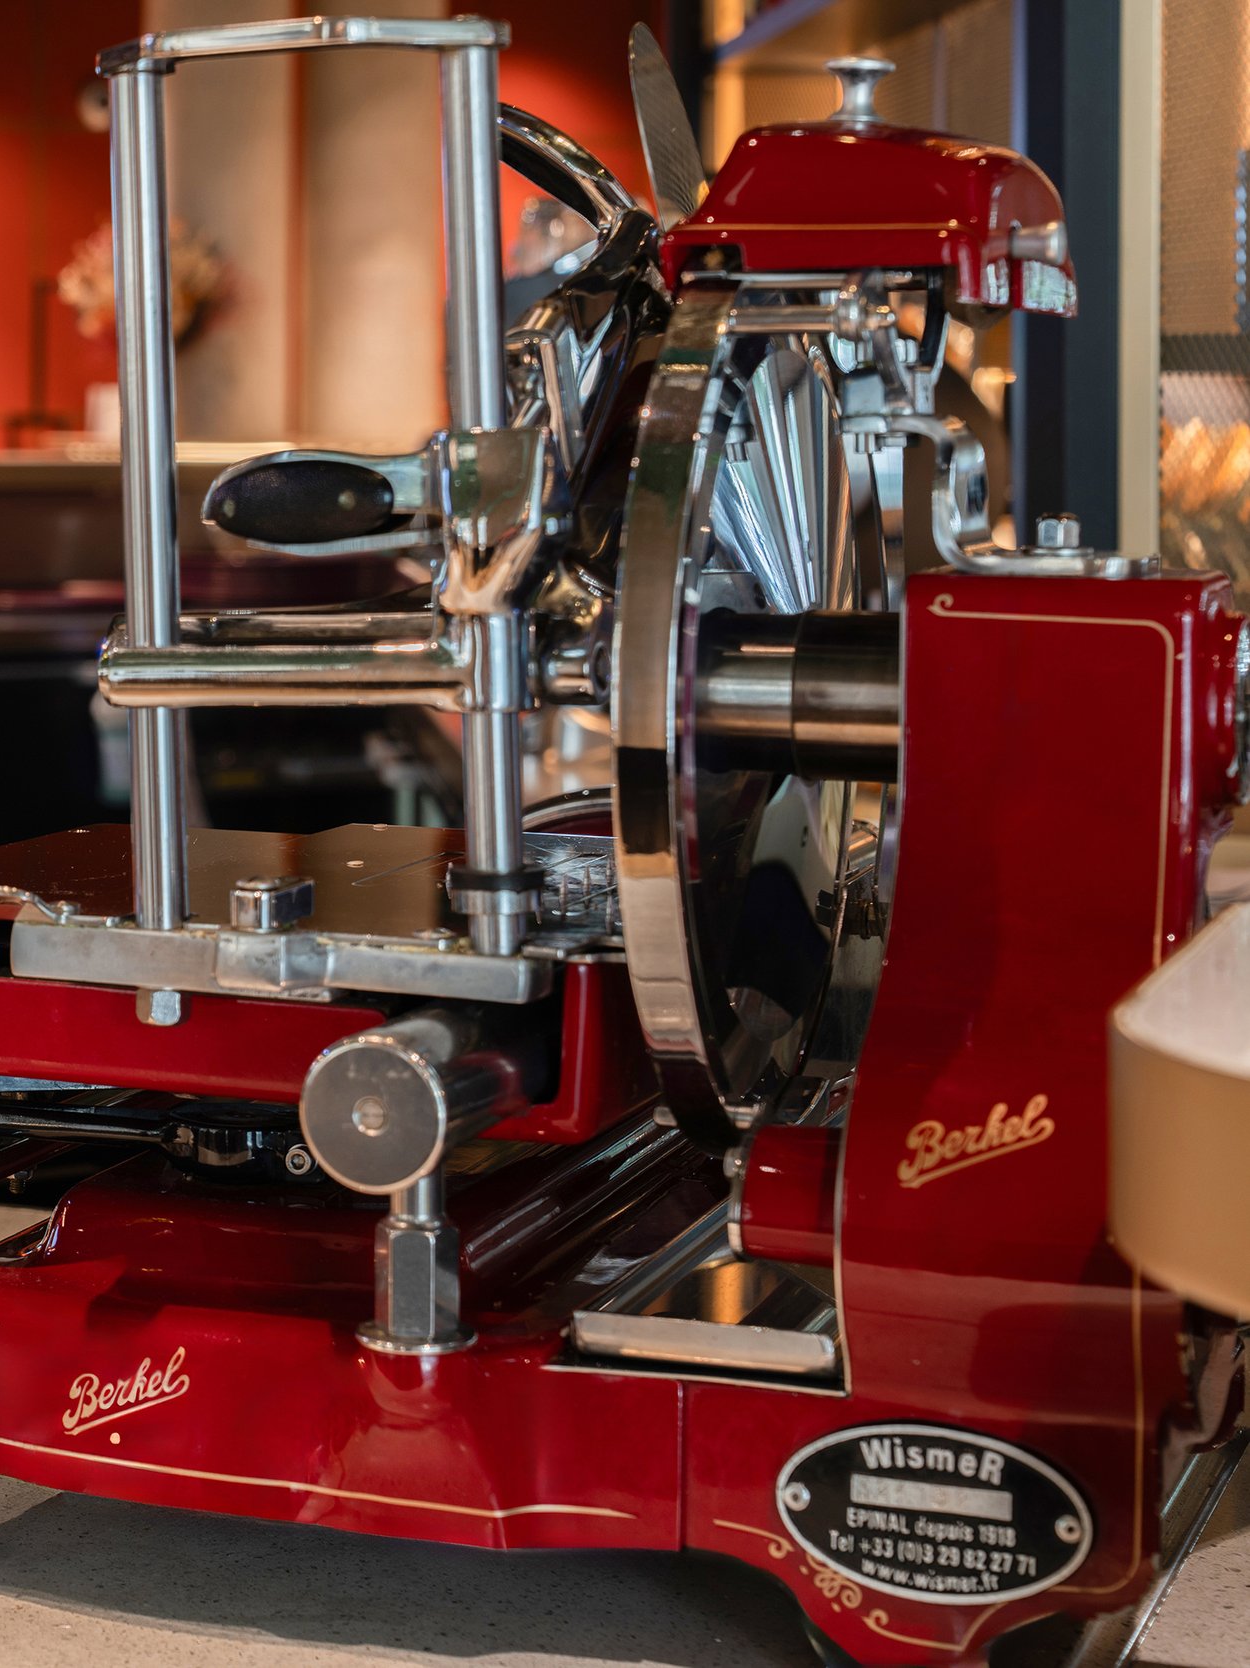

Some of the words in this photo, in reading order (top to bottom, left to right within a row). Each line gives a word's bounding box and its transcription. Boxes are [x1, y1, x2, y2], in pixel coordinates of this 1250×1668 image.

[897, 1094, 1055, 1189] Berkel
[62, 1346, 190, 1436] Berkel
[858, 1537, 894, 1559] +33
[989, 1550, 1013, 1574] 27
[1015, 1553, 1037, 1577] 71
